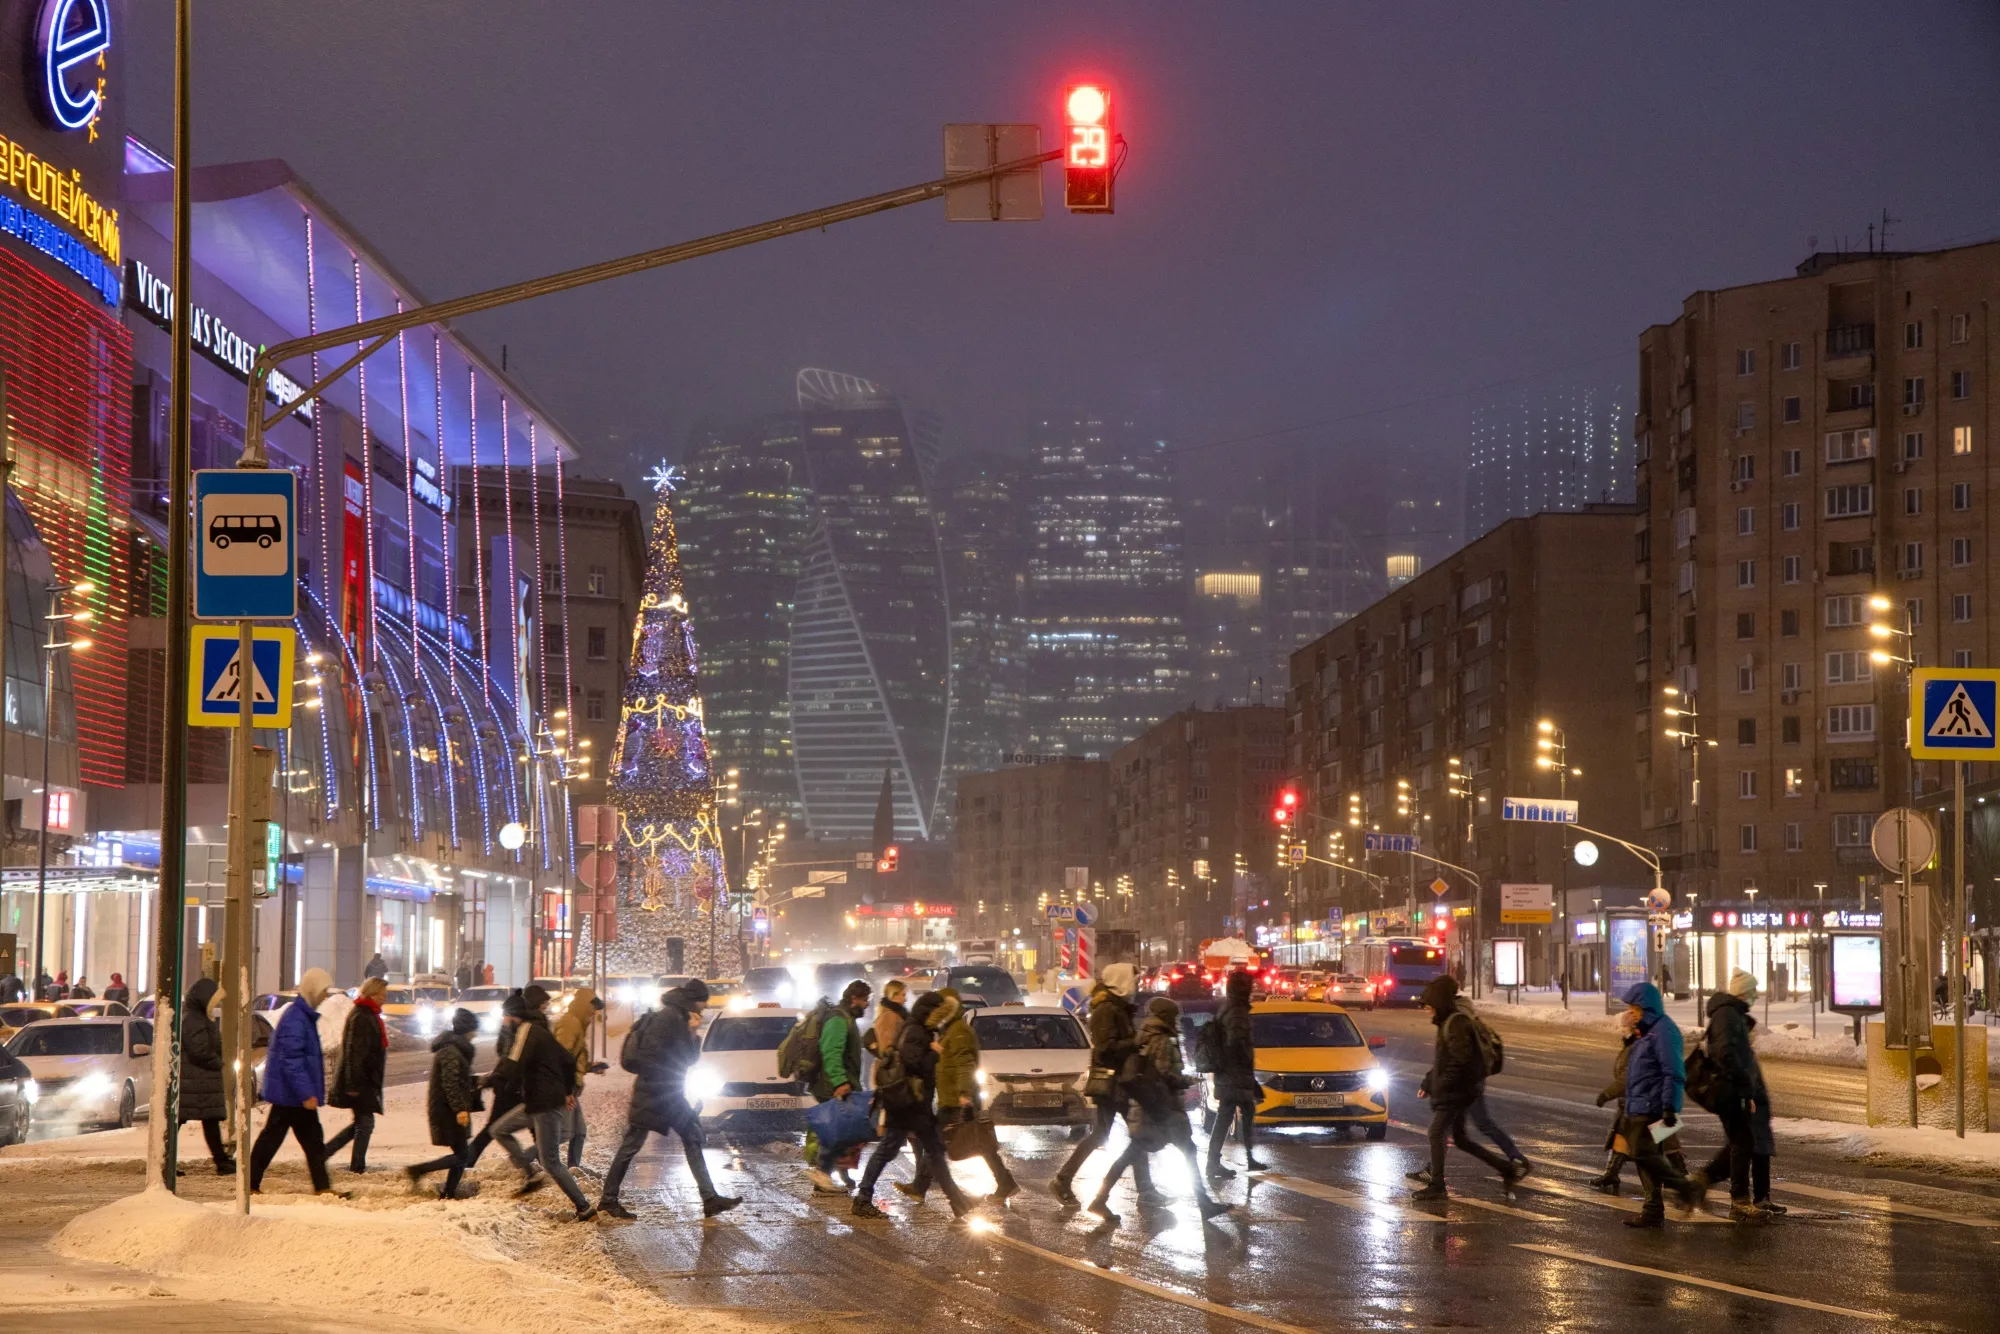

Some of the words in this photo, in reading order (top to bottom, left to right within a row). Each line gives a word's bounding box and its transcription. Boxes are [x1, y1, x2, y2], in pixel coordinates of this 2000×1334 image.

[1071, 126, 1106, 166] 29
[136, 261, 210, 348] VICTIA'S
[213, 317, 257, 375] SECRET
[1741, 912, 1783, 929] ЦВЕЫ
